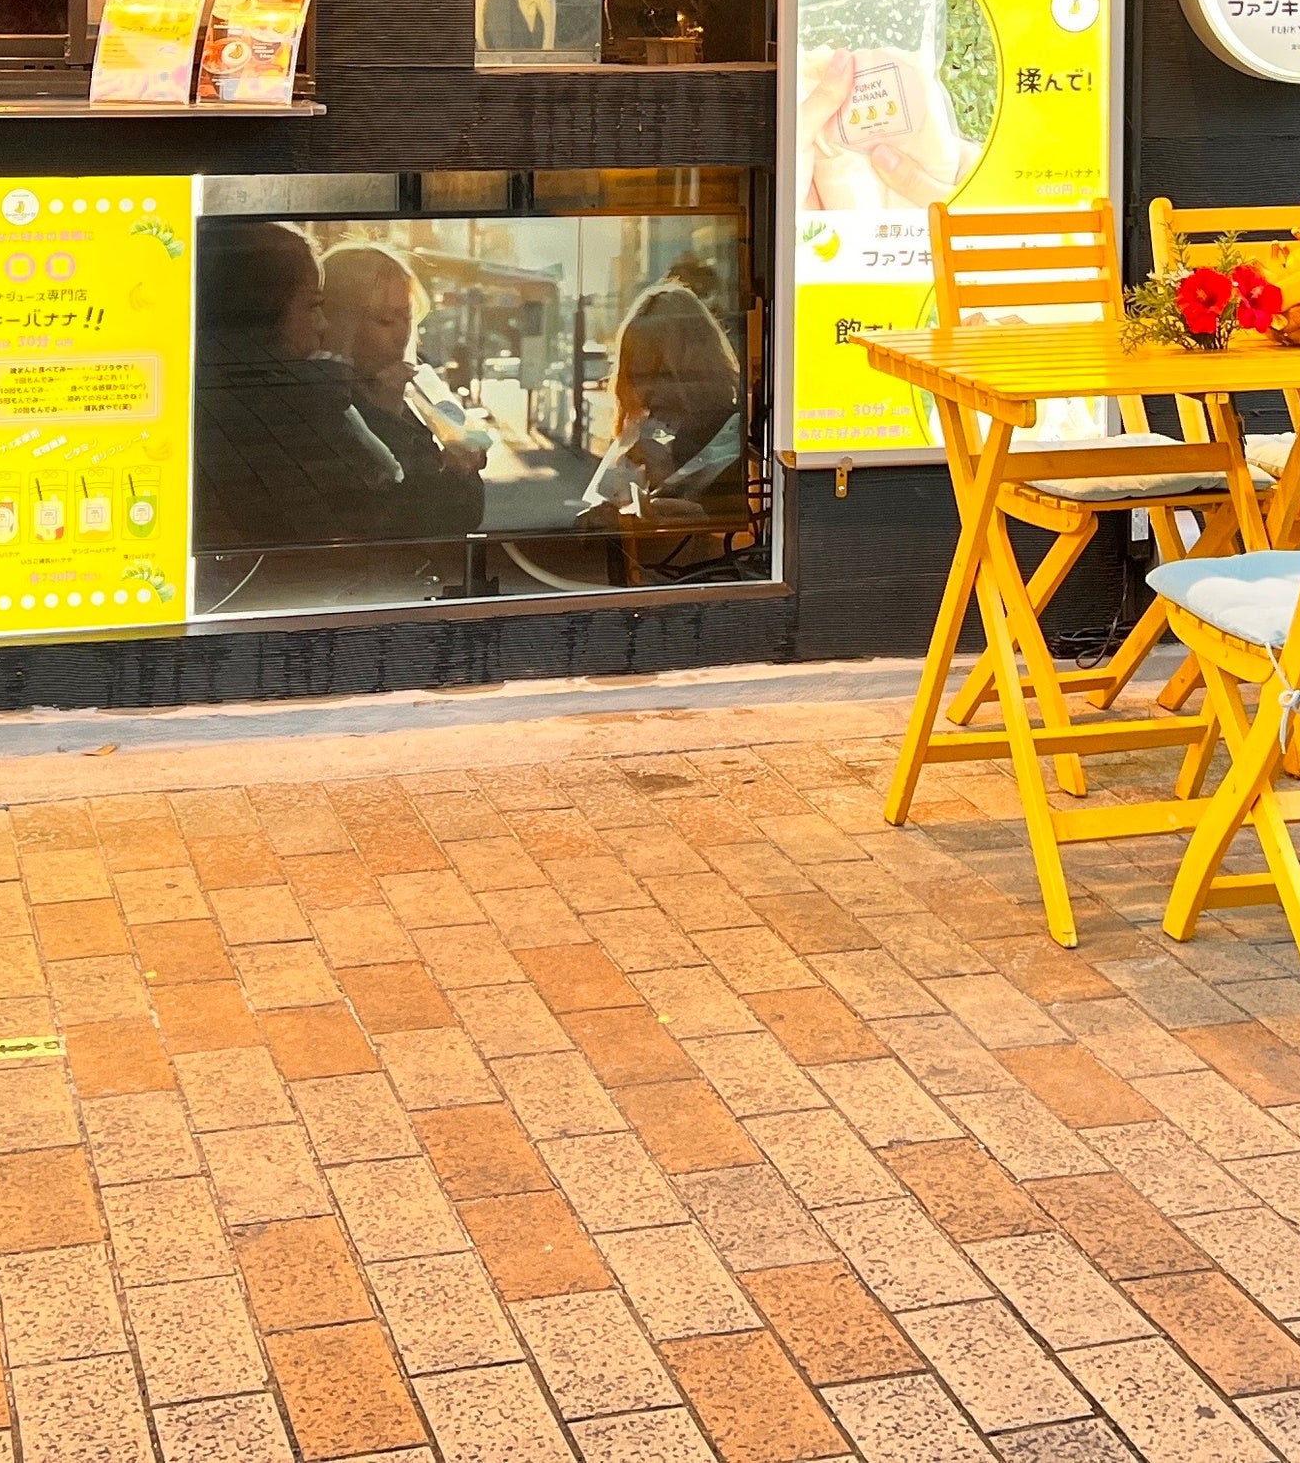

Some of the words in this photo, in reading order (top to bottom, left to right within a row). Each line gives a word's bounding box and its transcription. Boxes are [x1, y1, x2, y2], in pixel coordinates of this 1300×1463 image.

[1016, 67, 1092, 94] 揉んで!
[852, 89, 888, 104] BANANA
